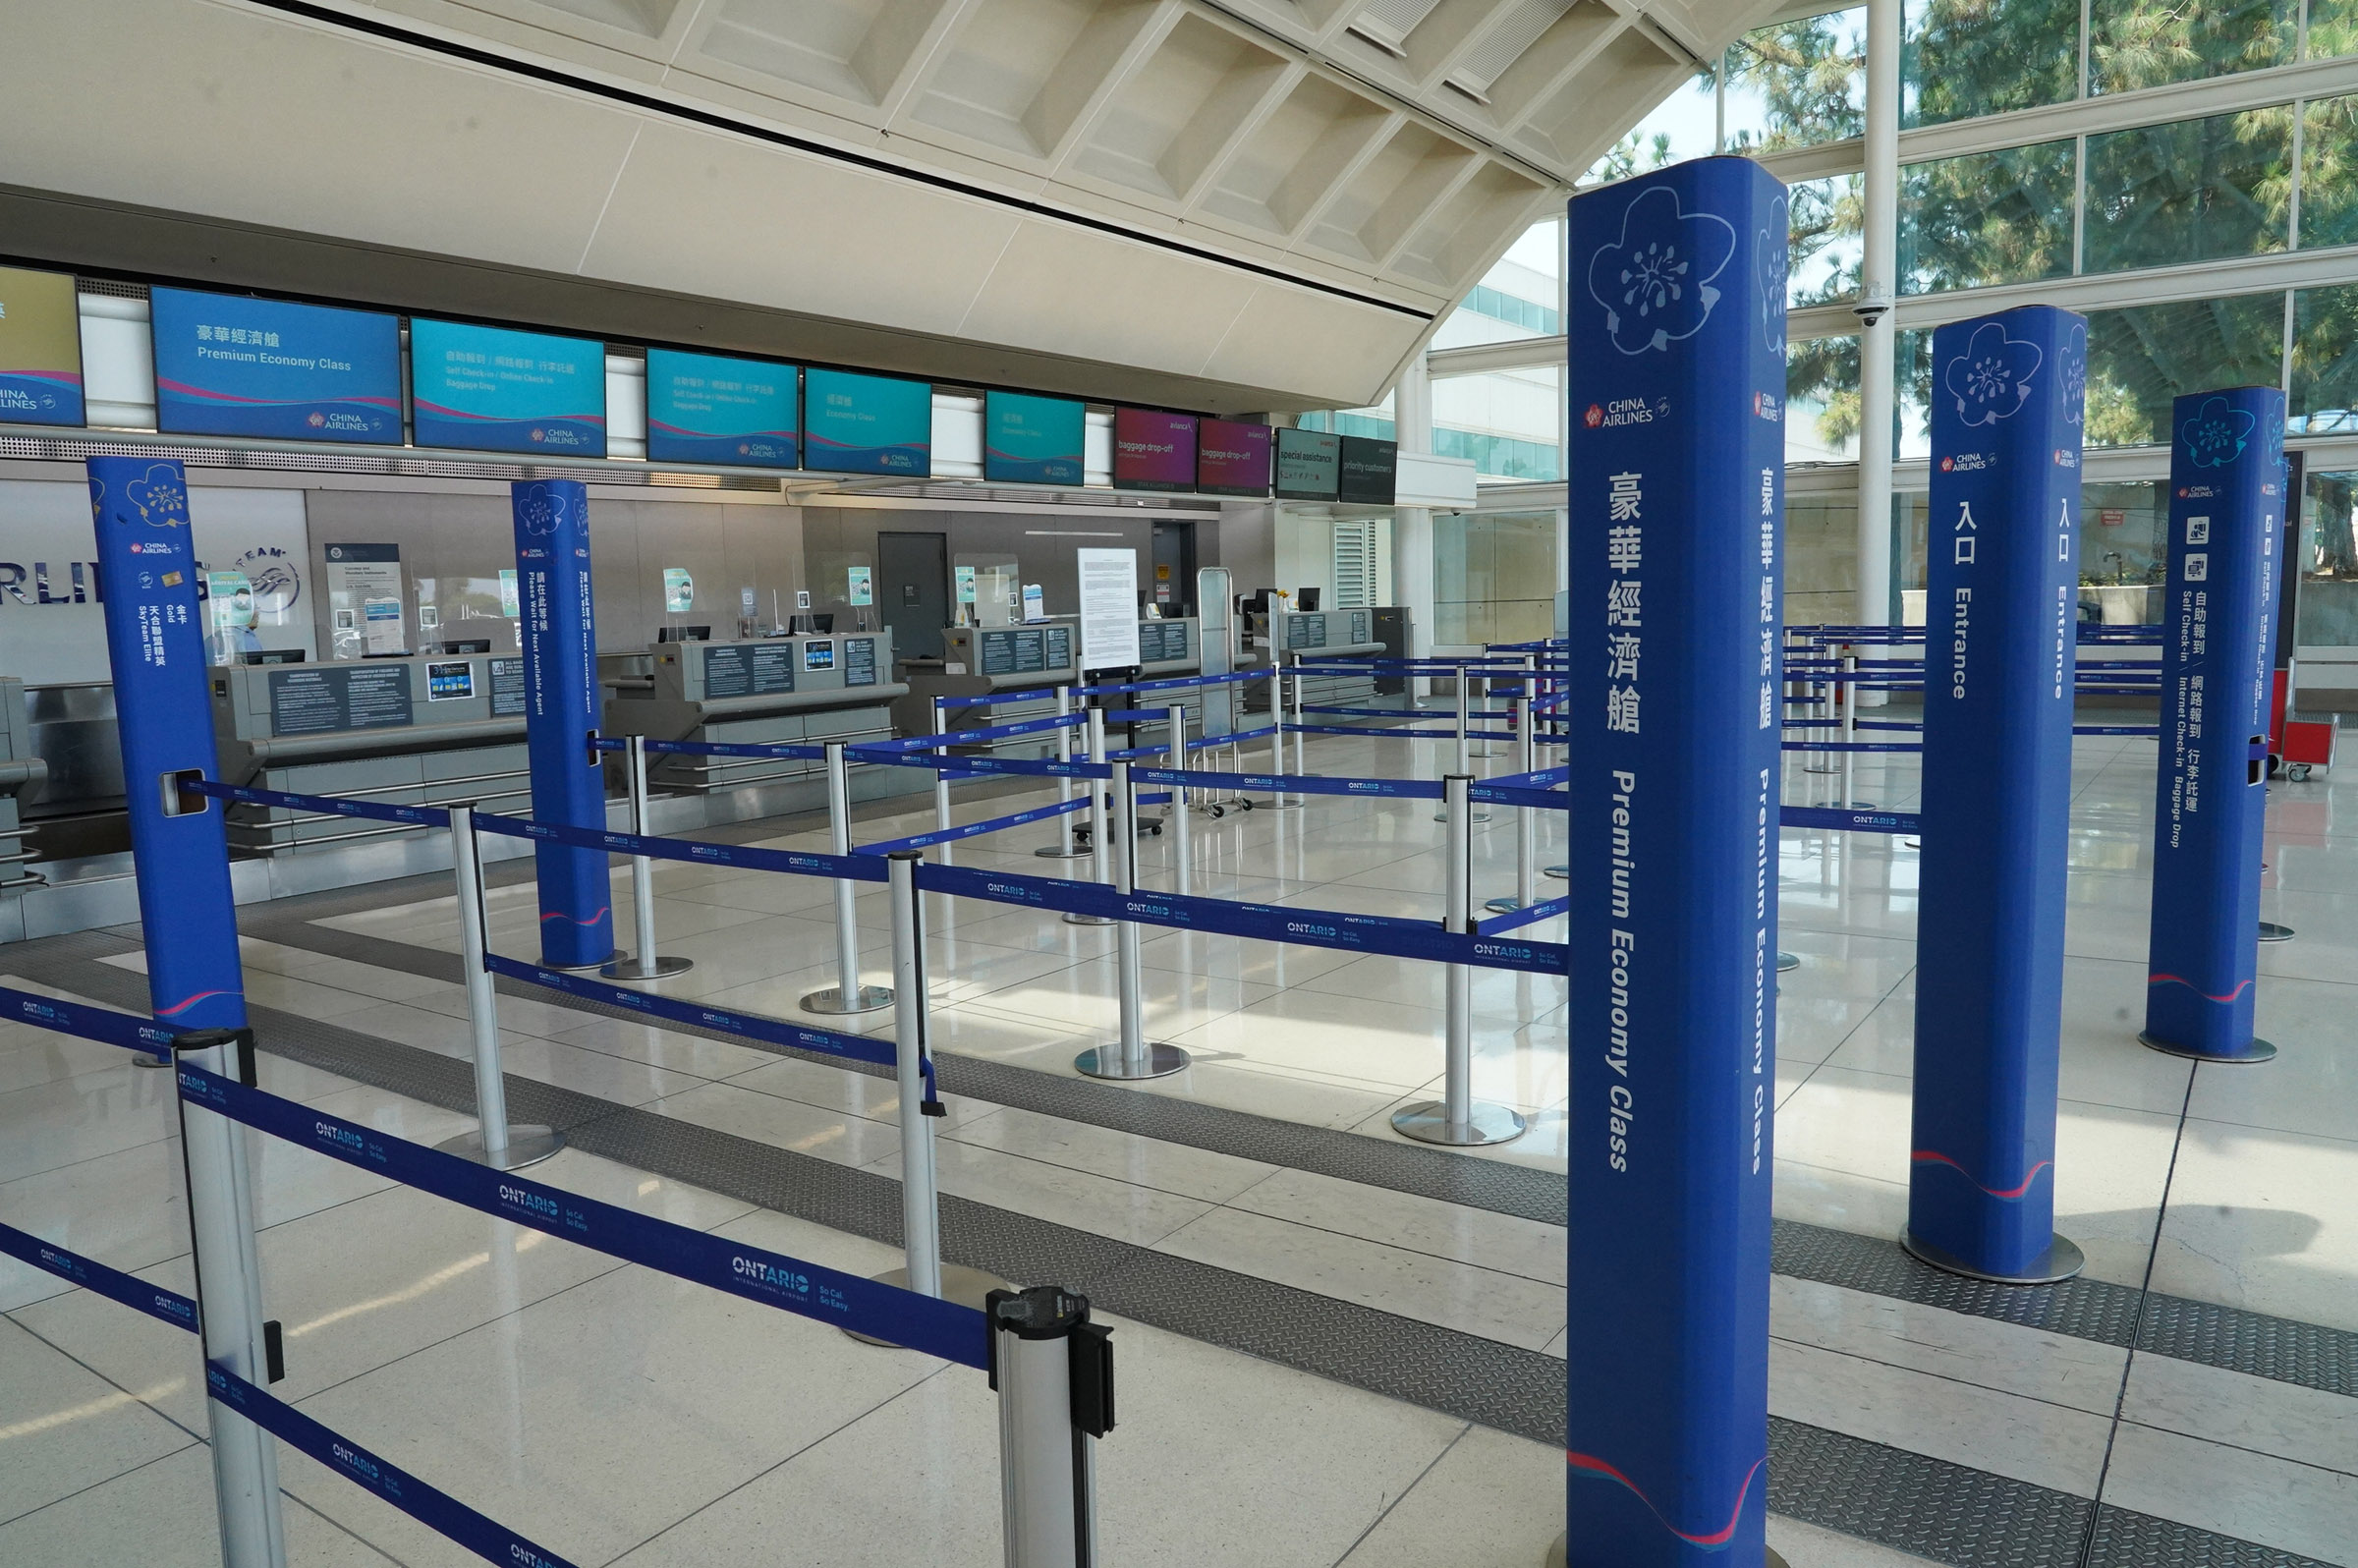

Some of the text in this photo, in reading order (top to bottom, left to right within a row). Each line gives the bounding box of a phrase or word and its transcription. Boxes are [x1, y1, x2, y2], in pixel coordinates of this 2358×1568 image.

[196, 324, 279, 348] 豪華經濟艙
[197, 346, 351, 371] Premium Economy Class
[446, 365, 461, 375] Self
[462, 367, 494, 378] Check-in
[524, 374, 553, 384] Check-in
[446, 379, 495, 391] Baggage Drop
[1608, 397, 1646, 414] CHINA
[1762, 393, 1775, 406] CHINA
[329, 413, 362, 422] CHINA
[1602, 410, 1654, 427] AIRLINES
[1761, 409, 1777, 421] AIRLINES
[324, 420, 368, 431] AIRLINES
[544, 436, 579, 445] AIRLINES
[1118, 439, 1174, 454] baggage drop-off
[1202, 449, 1251, 461] baggage drop-off
[1280, 451, 1332, 463] special assistance
[1956, 453, 1982, 464] CHINA
[2061, 449, 2073, 459] CHINA
[1344, 462, 1391, 473] priority customers
[1952, 460, 1986, 472] AIRLINES
[2059, 458, 2075, 468] AIRLINES
[1954, 501, 1977, 565] 入口
[2058, 497, 2070, 563] 入口
[1607, 471, 1643, 734] 豪華經濟艙
[1759, 467, 1773, 730] 豪華經濟艙
[176, 604, 188, 625] 金卡
[139, 605, 148, 643] SkyTeam
[1952, 588, 1972, 700] Entrance
[2054, 586, 2067, 700] Entrance
[2185, 590, 2207, 812] 自助報到 網路報到 行李託運
[2169, 590, 2192, 848] Self Check-in Internet Check-in Baggage Drop
[1147, 771, 1174, 780] ONTARIO
[1244, 777, 1272, 786] ONTARIO
[1853, 815, 1897, 825] ONTARIO
[525, 825, 548, 835] ONTARIO
[603, 835, 629, 845] ONTARIO
[692, 846, 718, 857] ONTARIO
[788, 857, 819, 868] ONTARIO
[987, 883, 1025, 896] ONTARIO
[1127, 902, 1169, 916] ONTARIO
[1287, 922, 1336, 936] ONTARIO
[1474, 944, 1532, 959] ONTARIO
[538, 972, 560, 982] ONTARIO
[1605, 769, 1636, 1173] Premium Economy Class
[1753, 767, 1769, 1175] Premium Economy Class
[616, 992, 641, 1004] ONTARIO
[23, 1001, 54, 1018] ONTARIO
[702, 1012, 729, 1025] ONTARIO
[799, 1033, 829, 1044] ONTARIO
[315, 1122, 364, 1148] ONTARIO
[499, 1185, 558, 1216] ONTARIO
[566, 1208, 573, 1217] So
[40, 1249, 72, 1269] ONTARIO
[732, 1257, 809, 1293] ONTARIO
[733, 1276, 808, 1303] INTERNATIONAL AIRPORT
[819, 1285, 828, 1295] So
[154, 1295, 191, 1316] ONTARIO
[819, 1296, 829, 1305] So
[333, 1443, 379, 1478] ONTARIO
